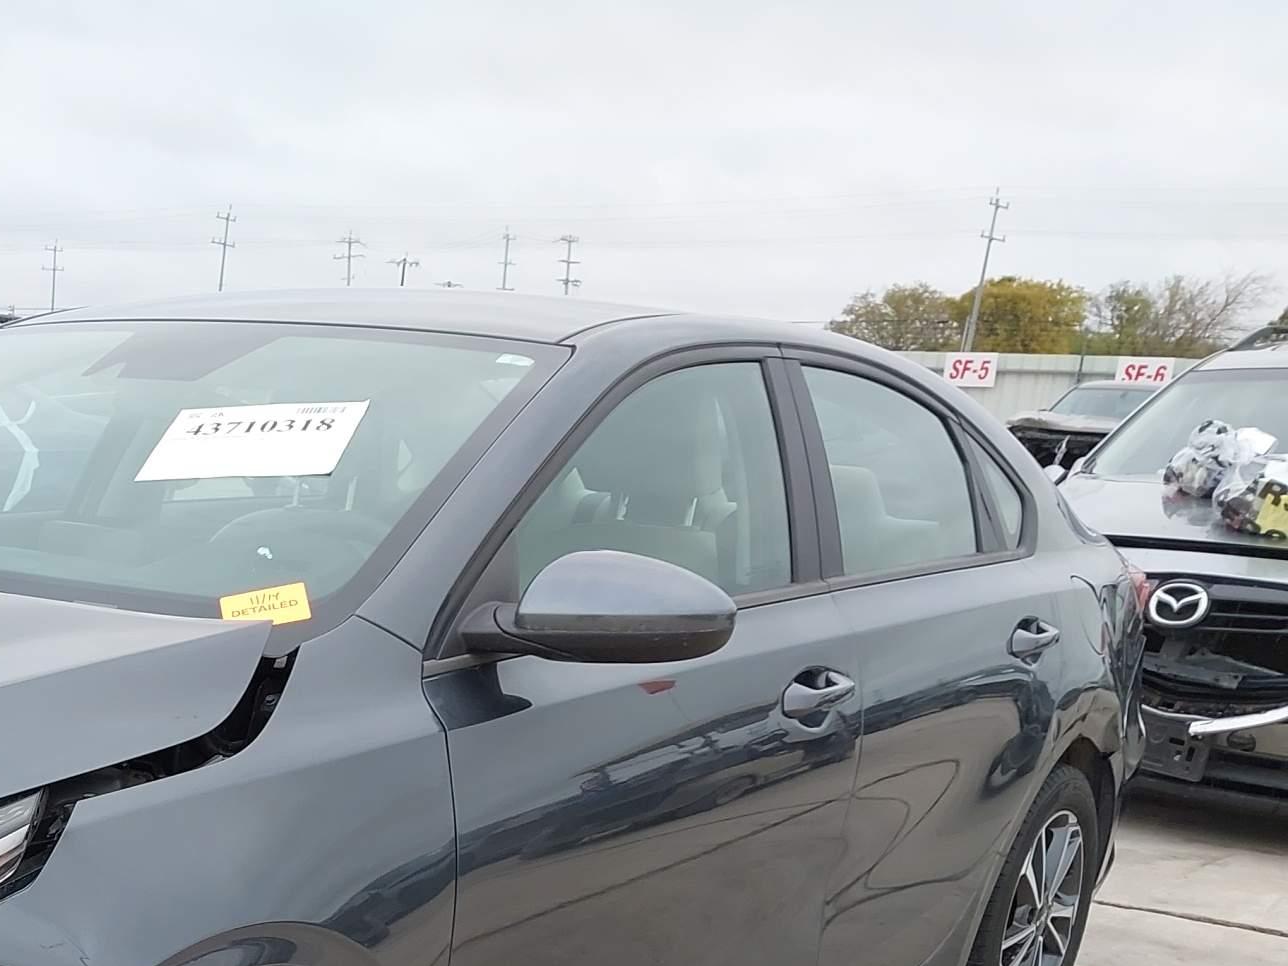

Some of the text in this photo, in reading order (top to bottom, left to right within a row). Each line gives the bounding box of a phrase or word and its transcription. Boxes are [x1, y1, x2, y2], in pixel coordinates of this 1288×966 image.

[949, 359, 992, 380] SF-5
[1121, 364, 1168, 382] SF-6
[185, 418, 336, 435] 43710318
[231, 599, 298, 617] DETAILED
